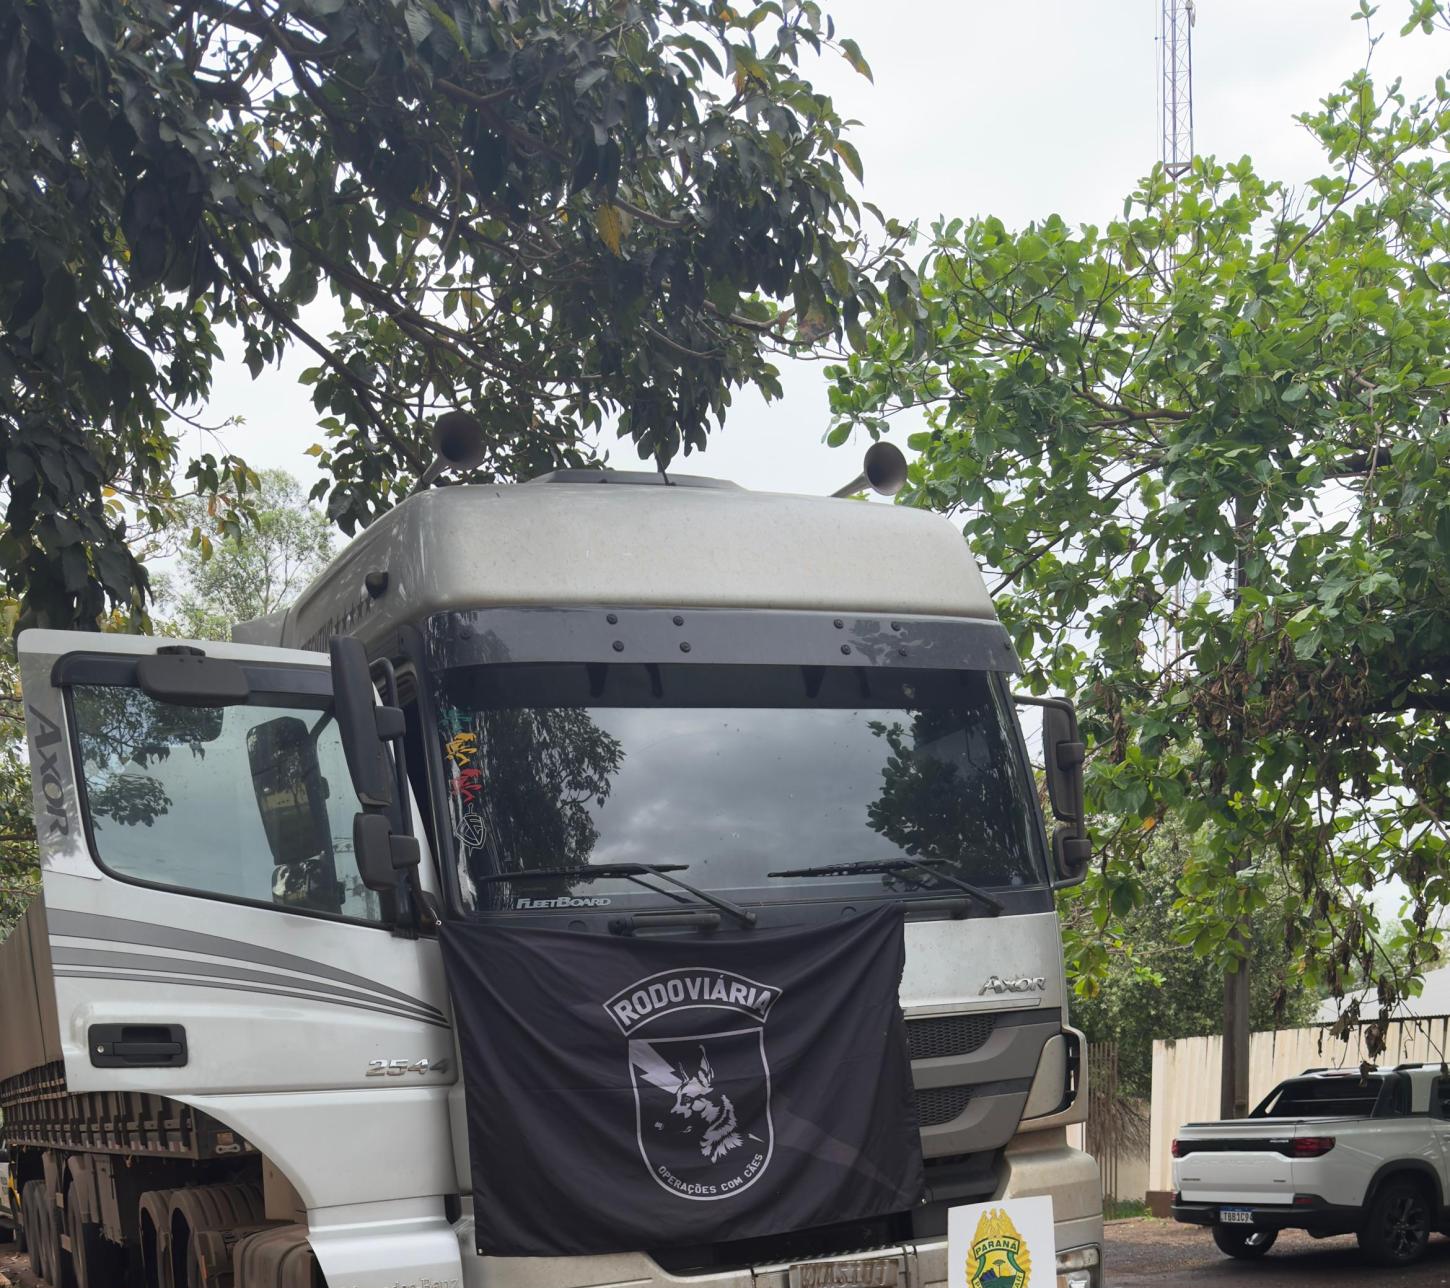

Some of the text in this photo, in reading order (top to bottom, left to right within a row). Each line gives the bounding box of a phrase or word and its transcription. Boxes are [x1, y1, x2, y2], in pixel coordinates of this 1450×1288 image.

[613, 974, 773, 1026] RODOVIÁRIA
[365, 1058, 449, 1076] 2544
[658, 1153, 763, 1194] OPERAÇÕES COM CÃES
[975, 1240, 1017, 1256] PARANÁ
